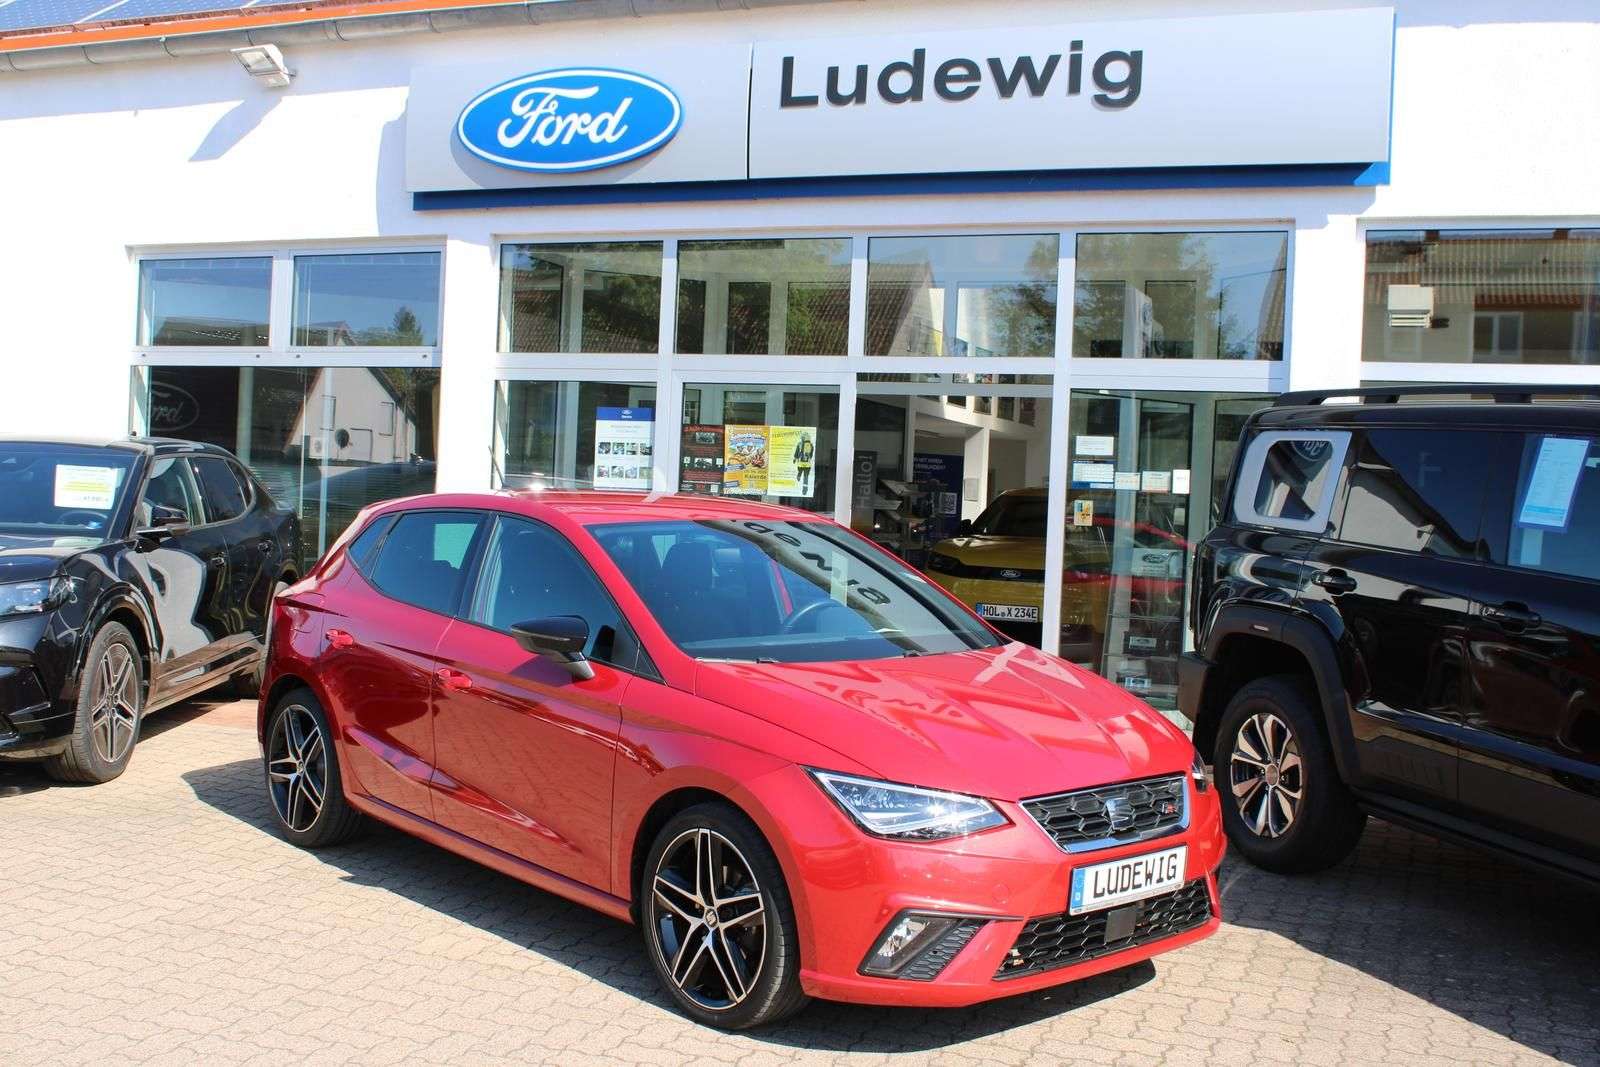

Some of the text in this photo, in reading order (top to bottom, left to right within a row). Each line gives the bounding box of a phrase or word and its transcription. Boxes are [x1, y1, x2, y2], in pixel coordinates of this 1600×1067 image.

[780, 40, 1144, 107] Ludewig
[498, 86, 633, 148] Ford
[982, 605, 1037, 619] HOL X 234E
[1093, 853, 1178, 899] LUDEWIG
